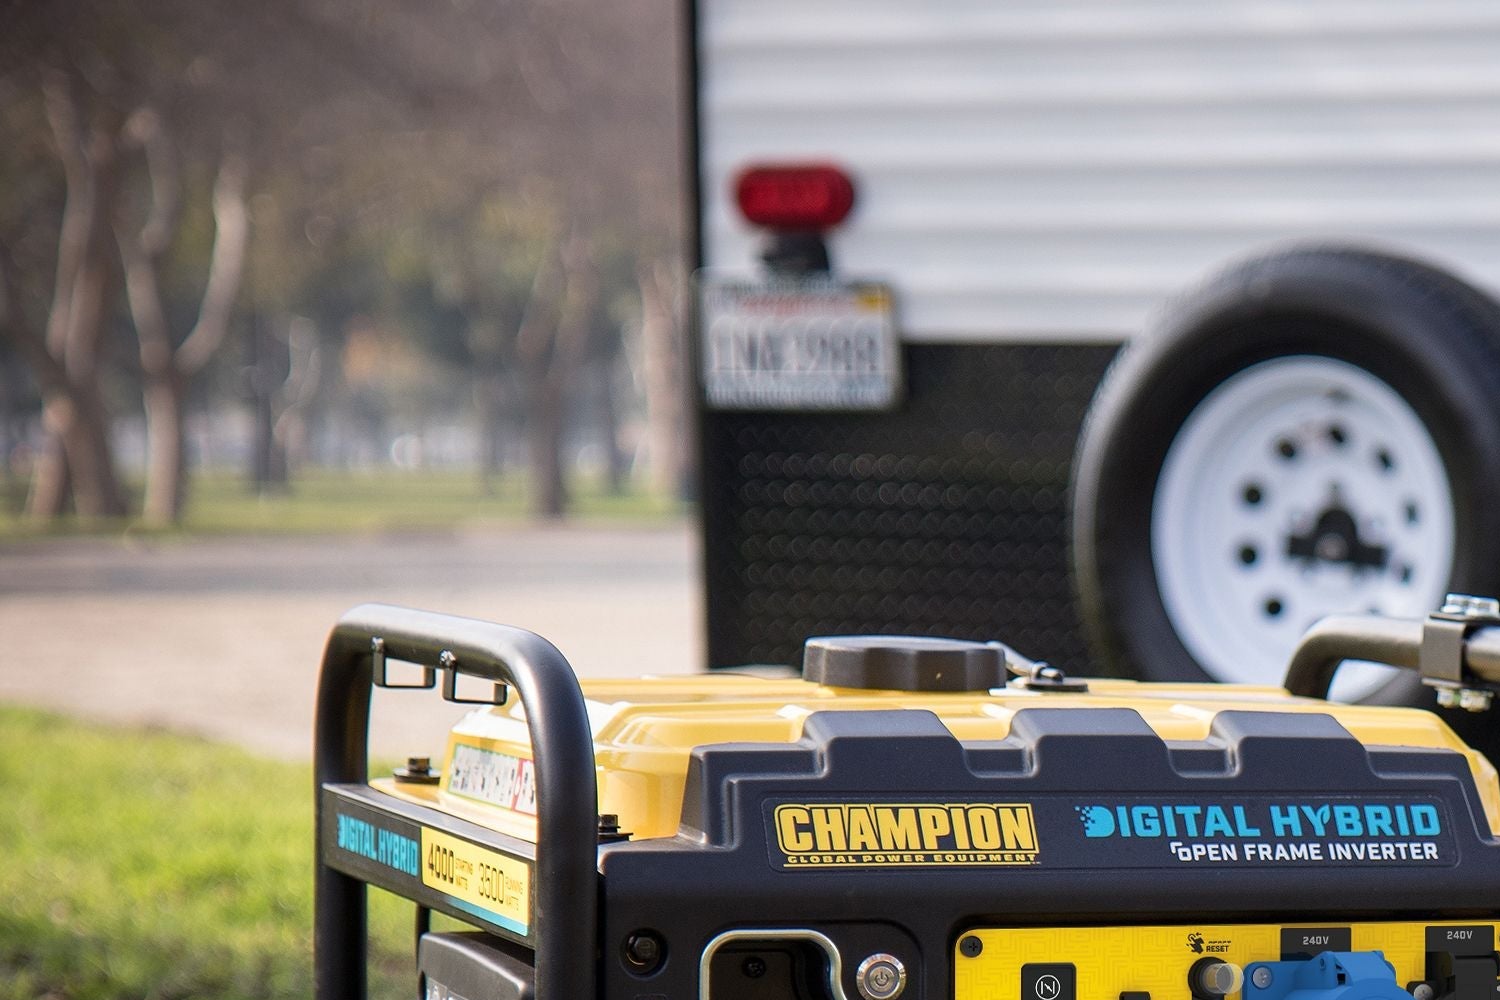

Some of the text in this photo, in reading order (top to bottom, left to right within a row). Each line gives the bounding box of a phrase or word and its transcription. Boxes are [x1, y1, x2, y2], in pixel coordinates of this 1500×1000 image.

[777, 805, 1037, 853] CHAMPION
[1076, 804, 1441, 838] DIGITAL HYBRID
[337, 812, 418, 876] DIGITAL HYBRID
[787, 853, 1036, 864] GLOBAL POWER EQUIPMENT
[1169, 841, 1439, 862] OPEN FRAME INVERTER
[428, 843, 454, 884] 4000
[479, 862, 504, 904] 3500
[1302, 935, 1329, 945] 240V
[1446, 930, 1473, 940] 240V
